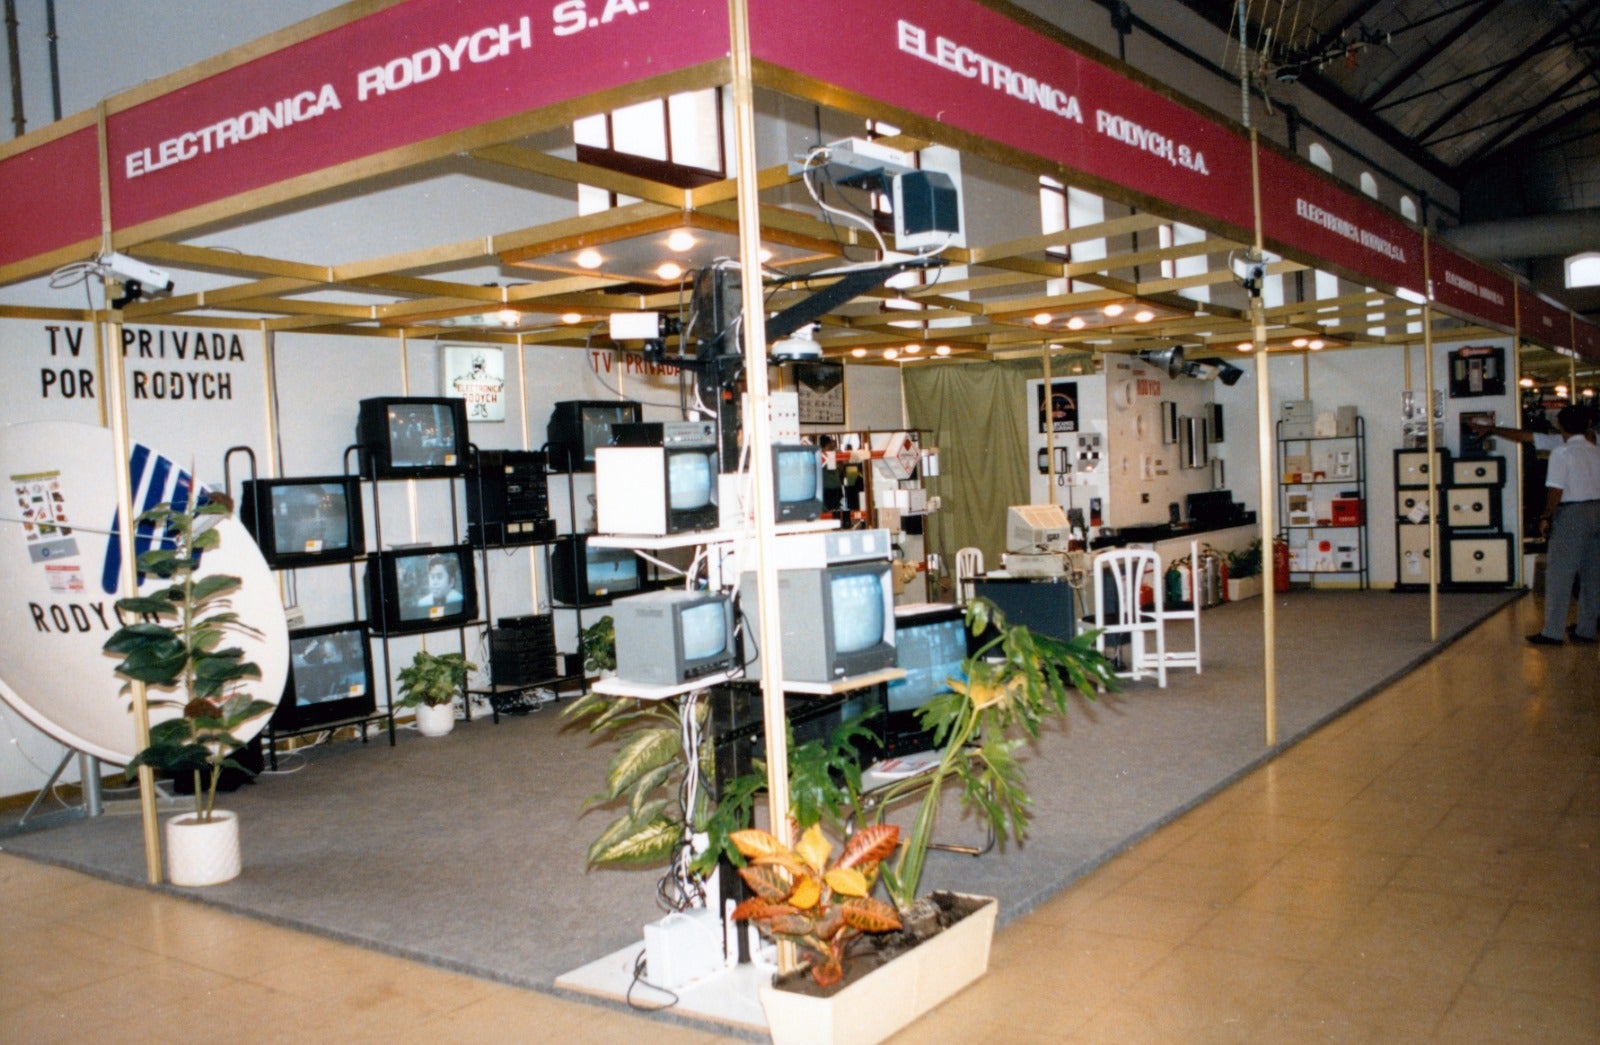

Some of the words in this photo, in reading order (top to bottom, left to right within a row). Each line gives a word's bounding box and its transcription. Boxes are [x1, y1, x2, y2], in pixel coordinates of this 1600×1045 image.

[898, 19, 1083, 124] ELECTRONICA
[125, 84, 341, 179] ELECTRONICA
[357, 16, 532, 102] RODYCH
[553, 0, 650, 36] S.A.
[45, 326, 84, 357] TV
[122, 328, 244, 361] PRIVADA
[592, 352, 612, 374] TV
[41, 368, 94, 398] POR
[134, 371, 232, 400] RODYCH
